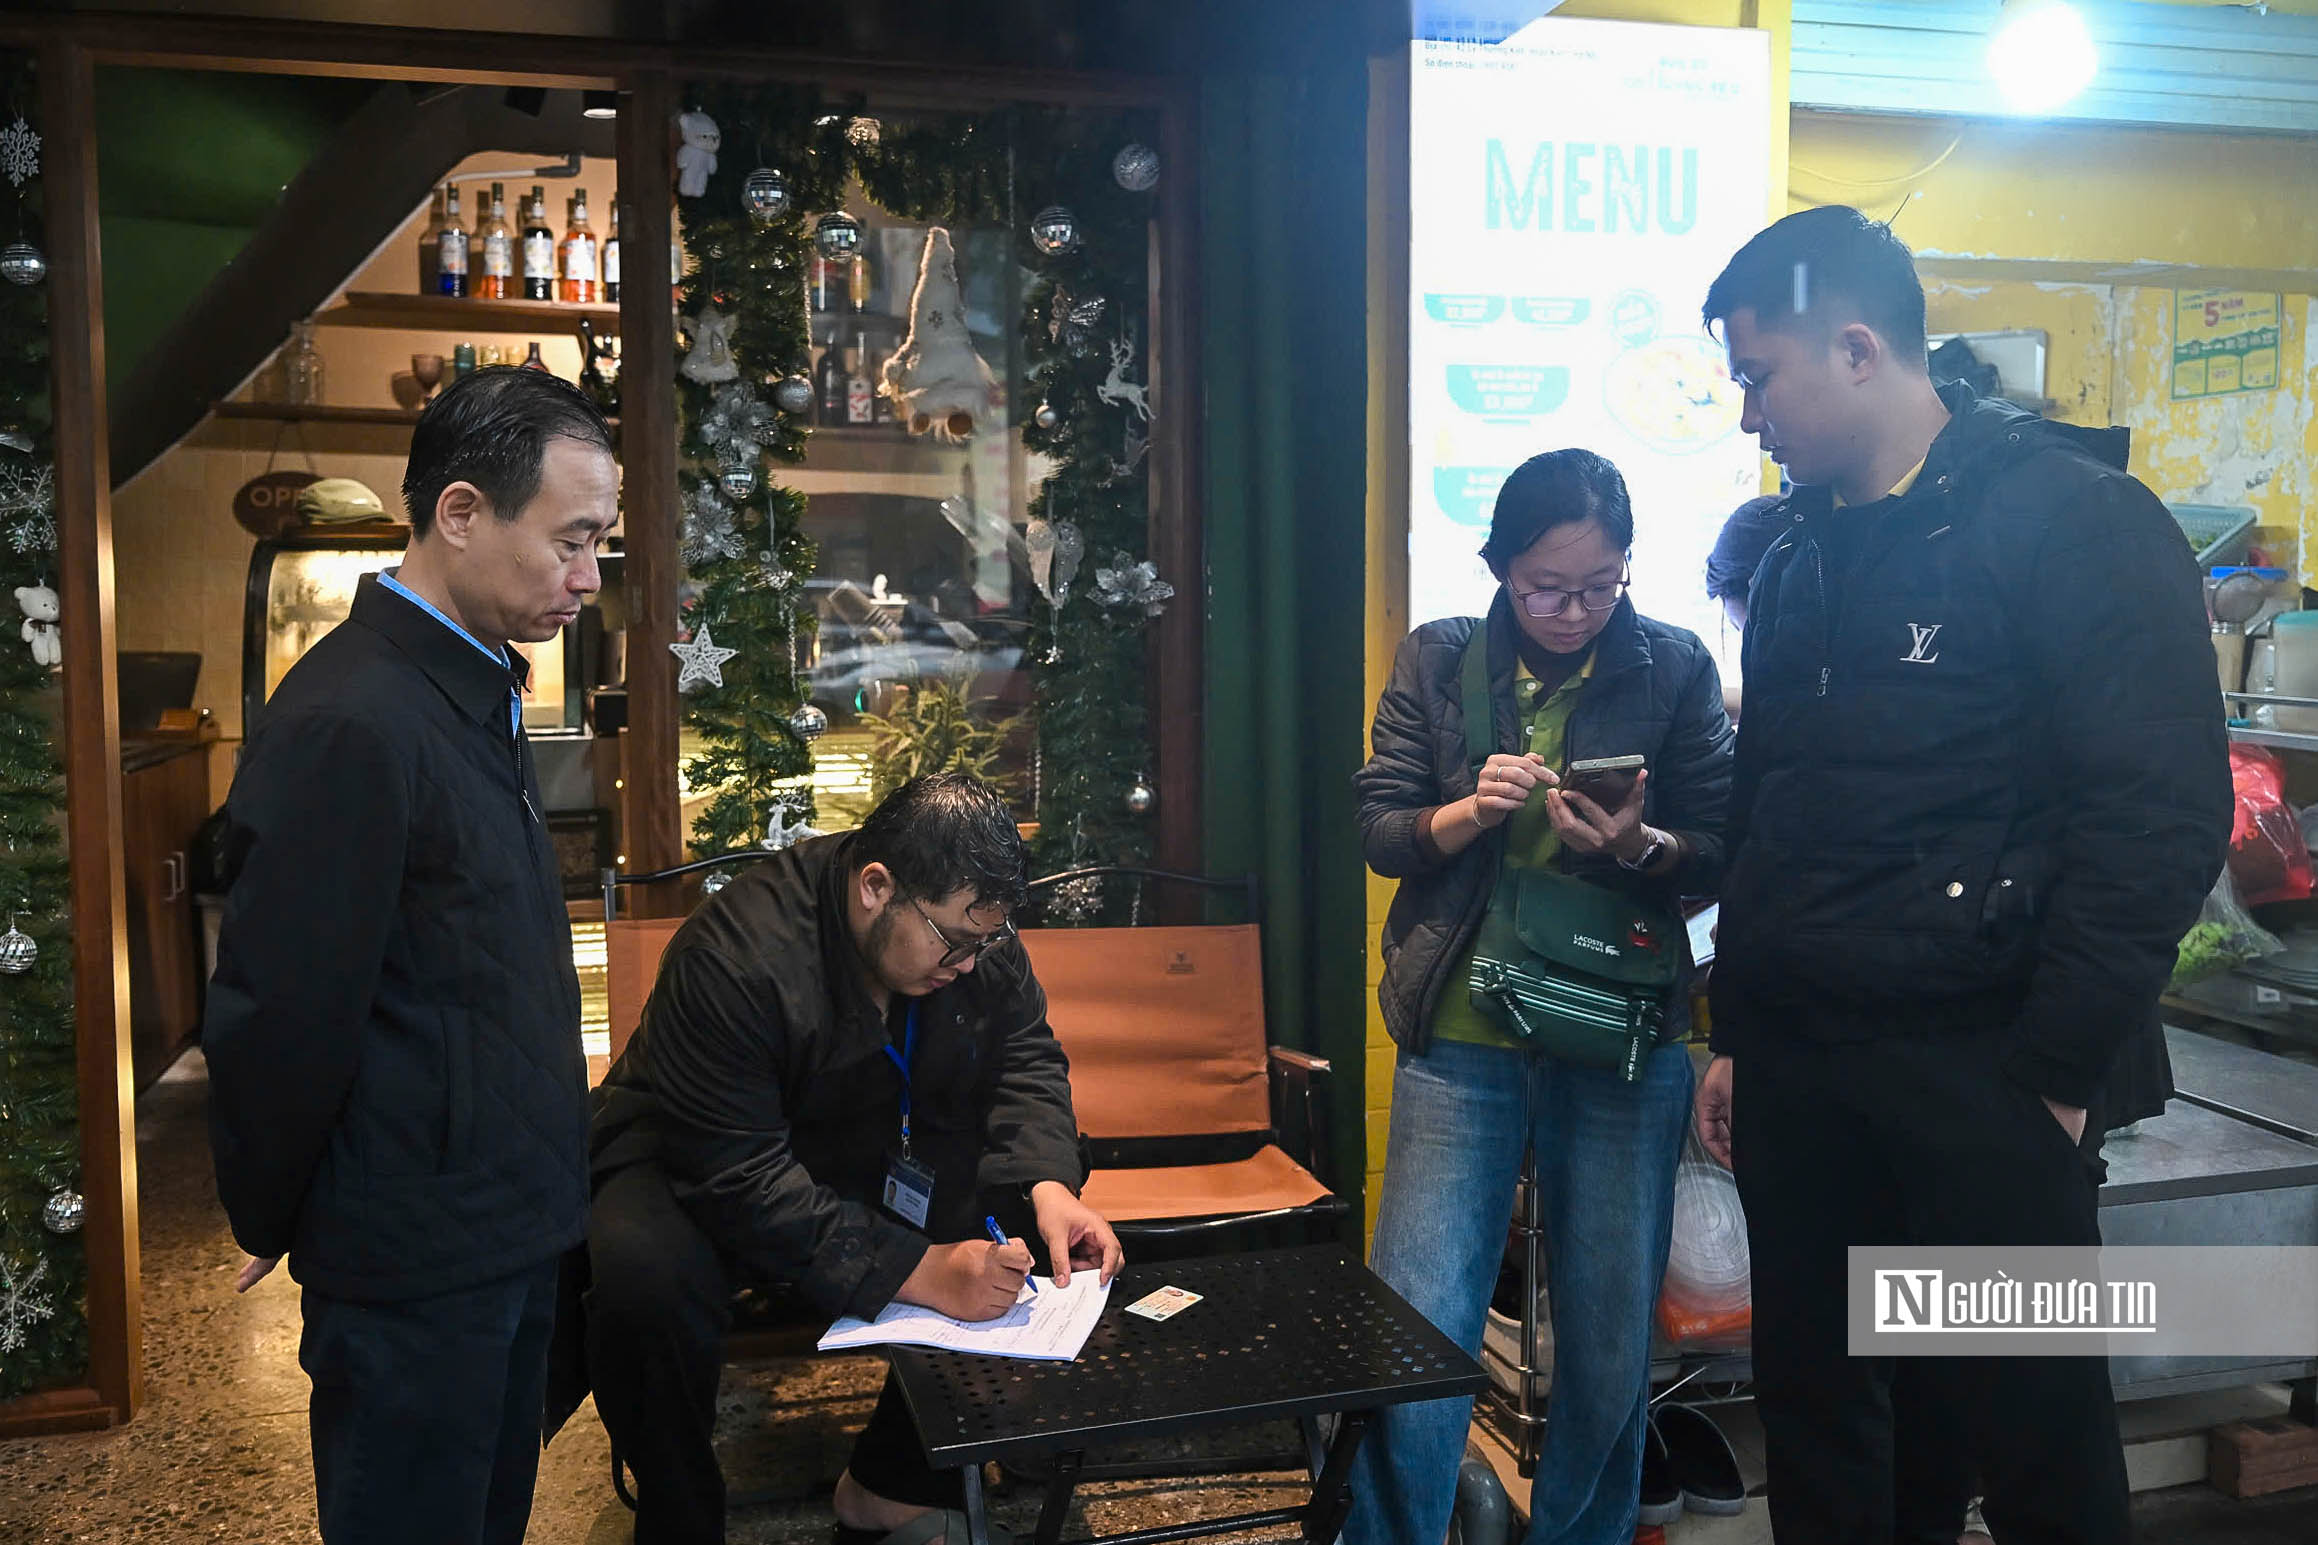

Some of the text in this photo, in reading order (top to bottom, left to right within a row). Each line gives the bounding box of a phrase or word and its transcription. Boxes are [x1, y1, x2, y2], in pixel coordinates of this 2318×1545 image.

[1484, 138, 1699, 235] MENU
[2205, 301, 2219, 327] 5
[1573, 934, 1604, 948] LACOSTE
